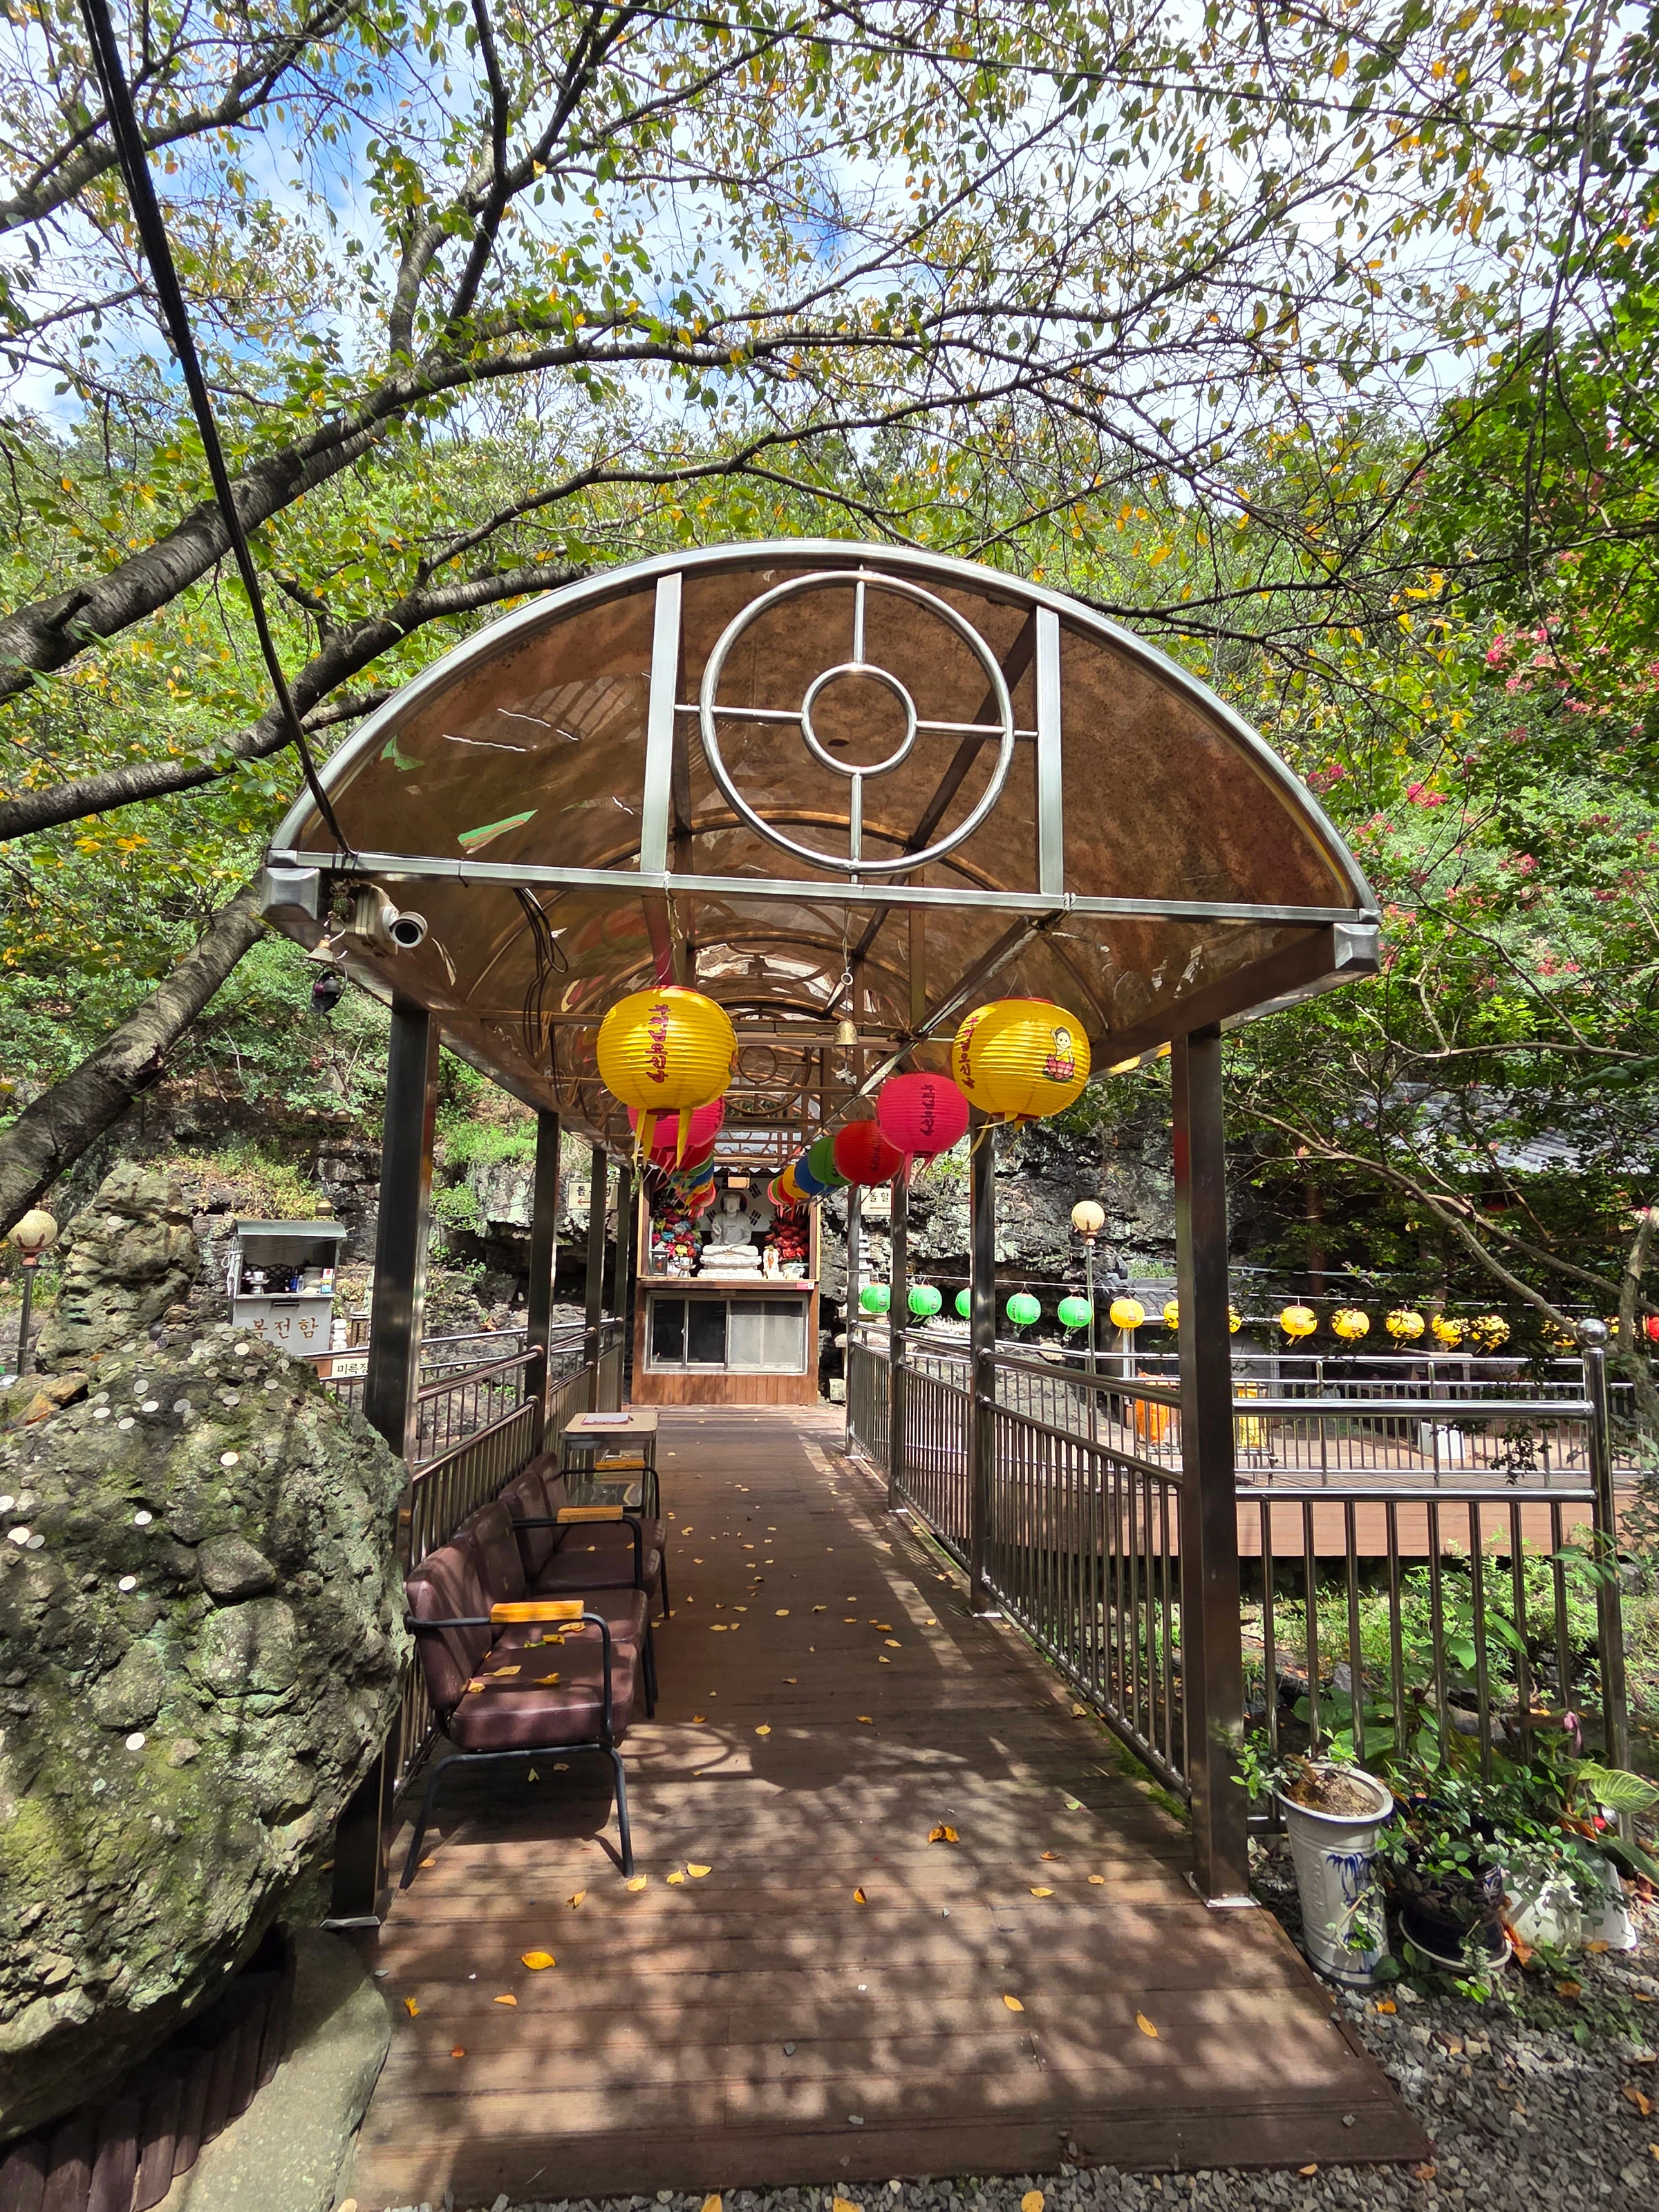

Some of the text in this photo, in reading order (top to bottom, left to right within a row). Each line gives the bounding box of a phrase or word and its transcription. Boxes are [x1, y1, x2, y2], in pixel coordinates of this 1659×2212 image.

[644, 1004, 672, 1083] 부처님오신날
[868, 1192, 891, 1203] 돌할
[250, 1317, 319, 1339] 복전함
